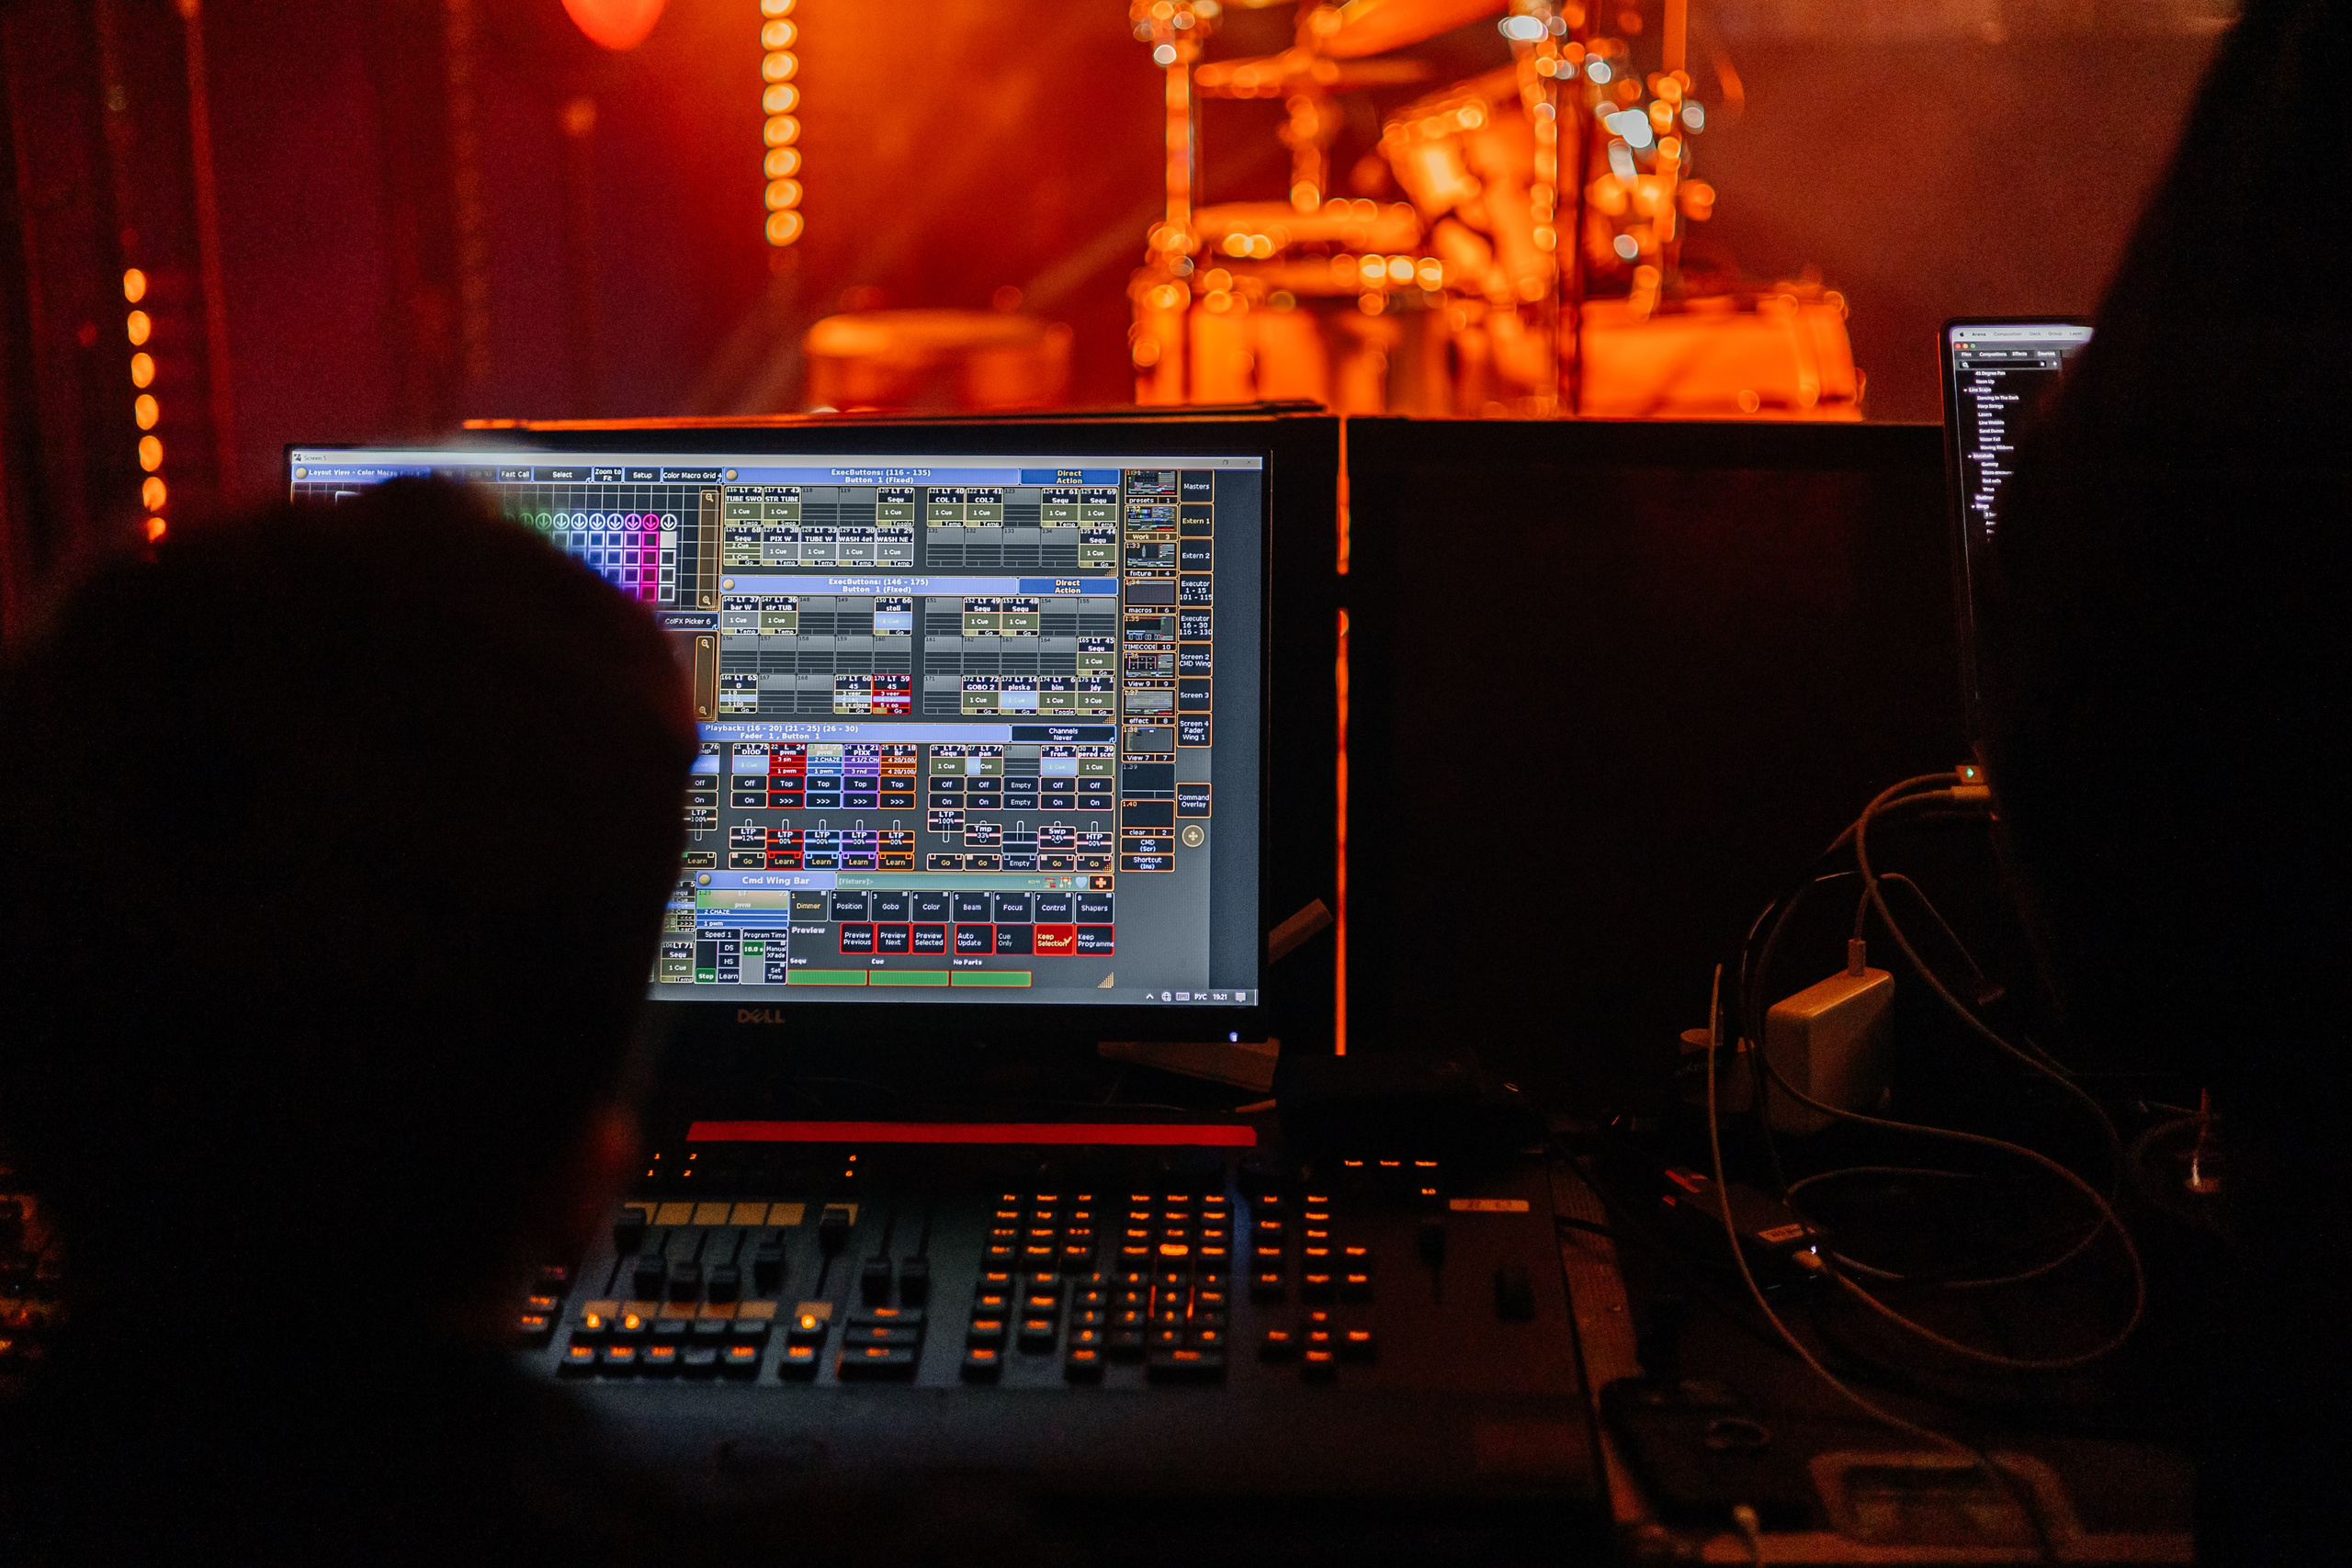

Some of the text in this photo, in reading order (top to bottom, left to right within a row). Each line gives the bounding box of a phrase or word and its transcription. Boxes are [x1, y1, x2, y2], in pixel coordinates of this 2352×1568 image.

[742, 876, 764, 885] Cmd
[767, 877, 790, 886] Wing
[1081, 905, 1107, 913] Shapers
[998, 940, 1012, 948] Only
[738, 1010, 785, 1023] DELL
